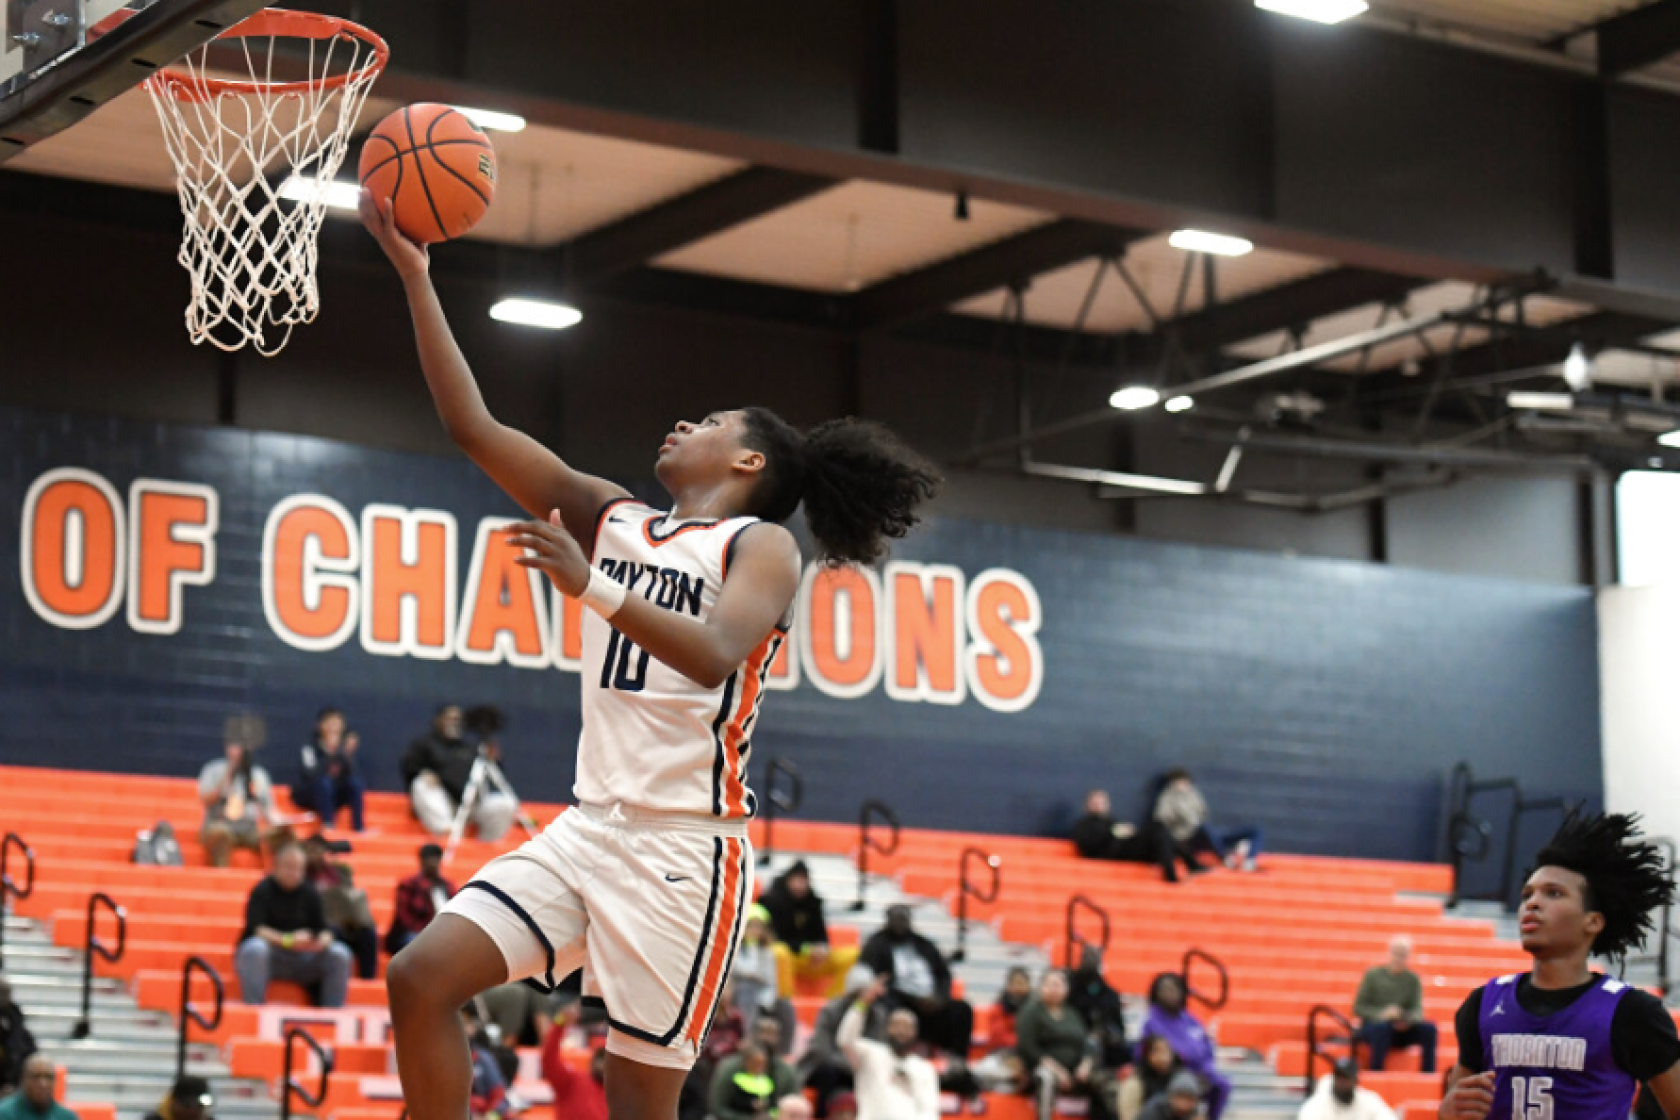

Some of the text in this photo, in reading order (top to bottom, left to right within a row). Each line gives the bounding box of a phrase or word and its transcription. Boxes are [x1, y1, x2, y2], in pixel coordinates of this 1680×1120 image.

[20, 466, 1044, 713] OF CHAONS
[600, 627, 650, 692] 10
[1491, 1032, 1587, 1072] THORNTON
[1511, 1076, 1554, 1120] 15
